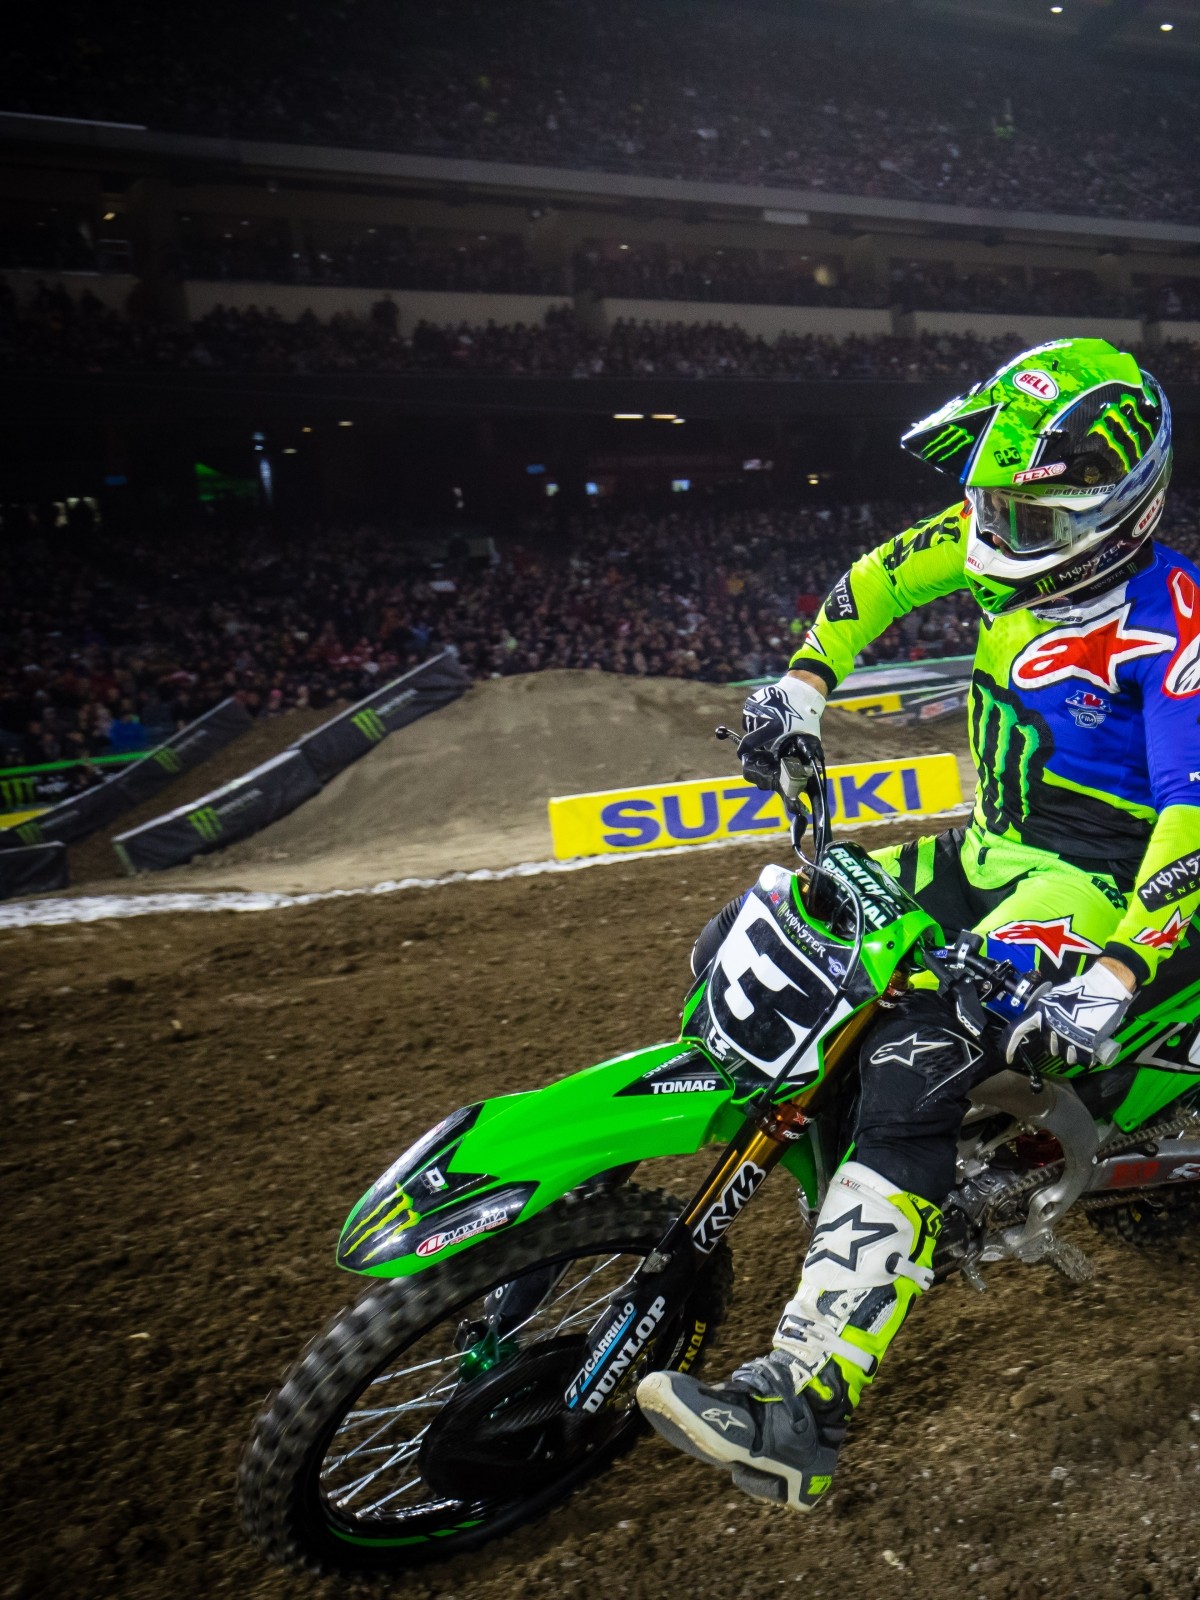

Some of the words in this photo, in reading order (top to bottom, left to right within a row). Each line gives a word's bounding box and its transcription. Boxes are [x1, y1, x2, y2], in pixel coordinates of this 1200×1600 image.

[1019, 373, 1049, 395] BELL
[995, 448, 1021, 465] PPG
[1013, 465, 1053, 484] FLEX
[967, 556, 981, 570] BELL
[1058, 540, 1127, 582] MONSTER
[833, 568, 854, 618] STER
[822, 857, 888, 930] REAL
[783, 908, 827, 958] MONSTER
[708, 917, 838, 1063] 3
[651, 1079, 716, 1094] TOMAC
[692, 1160, 767, 1255] KYB
[582, 1295, 666, 1414] DUNLOP
[584, 1301, 635, 1372] CARRILLO
[677, 1319, 707, 1373] DUNL
